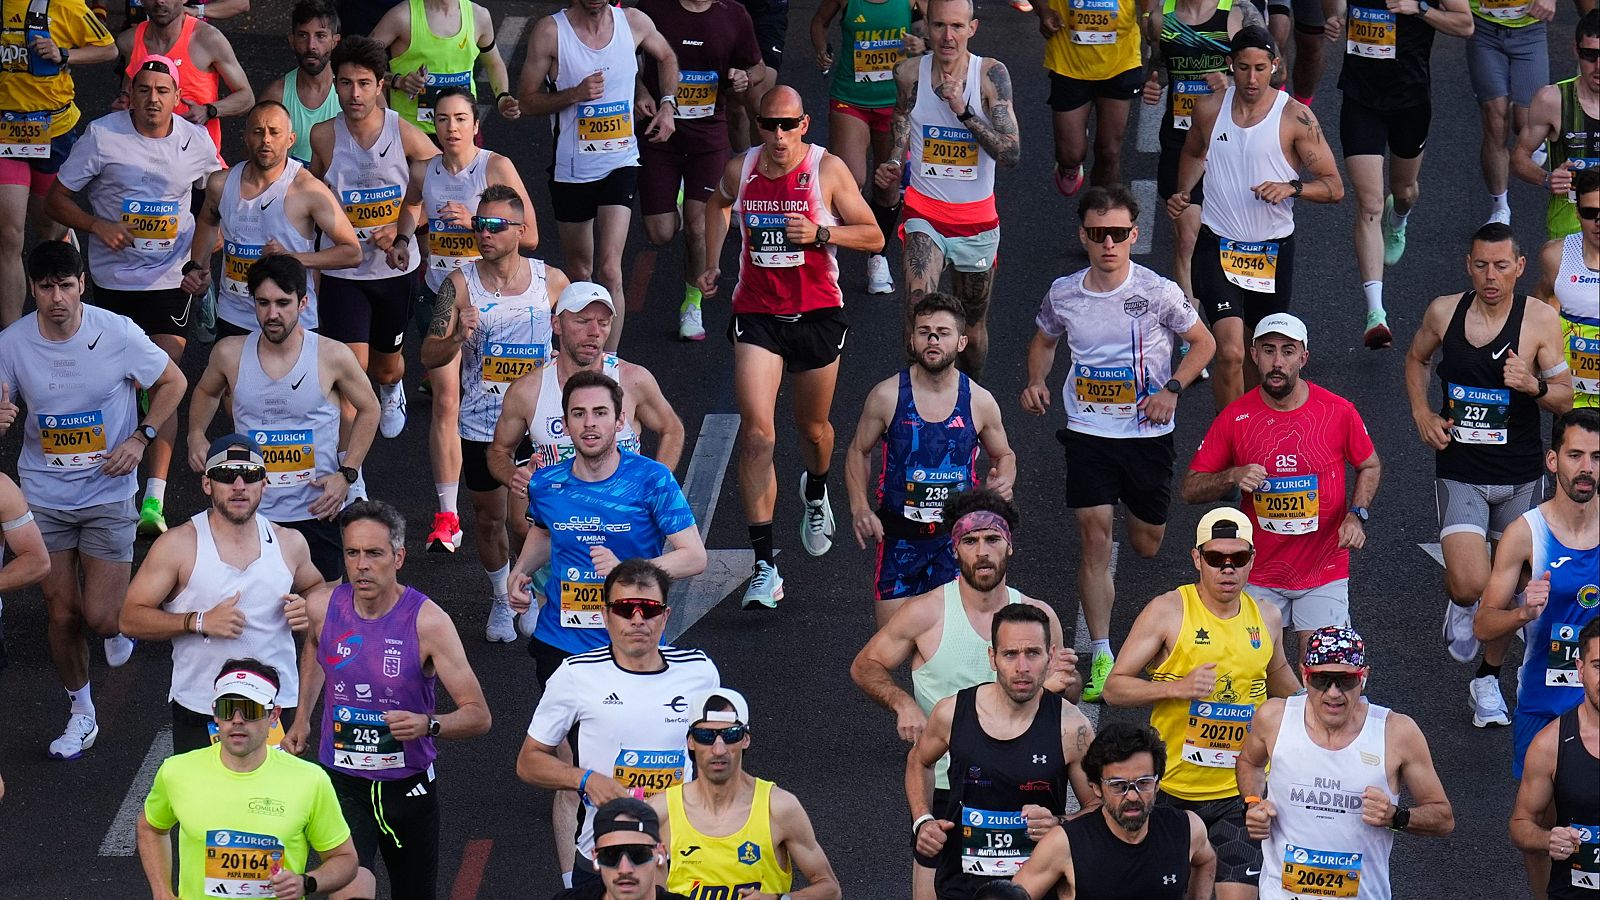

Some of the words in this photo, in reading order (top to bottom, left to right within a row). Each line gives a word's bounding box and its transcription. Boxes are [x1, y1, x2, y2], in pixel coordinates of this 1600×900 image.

[1077, 13, 1109, 25] 20336
[1355, 24, 1385, 38] 20178
[865, 52, 897, 65] 20510
[1169, 54, 1224, 69] TRIWILD
[677, 87, 708, 98] 20733
[598, 104, 625, 114] ZURICH
[9, 125, 41, 137] 20535
[590, 119, 620, 132] 20551
[943, 130, 973, 139] ZURICH
[933, 144, 967, 158] 20128
[365, 190, 395, 200] ZURICH
[357, 205, 392, 219] 20603
[743, 201, 779, 211] PUERTAS
[780, 201, 809, 212] LORCA
[132, 218, 167, 231] 20672
[439, 237, 473, 249] 20590
[761, 231, 784, 244] 218
[238, 248, 262, 256] ZURIC
[232, 262, 250, 275] 205
[1231, 256, 1265, 270] 20546
[495, 361, 533, 375] 20473
[1087, 383, 1122, 396] 20257
[1468, 392, 1502, 401] ZURICH
[61, 415, 95, 425] ZURICH
[1464, 406, 1489, 421] 237
[53, 431, 91, 446] 20671
[271, 433, 305, 442] ZURICH
[263, 450, 301, 463] 20440
[1275, 454, 1297, 467] as
[930, 471, 961, 480] ZURICH
[1275, 480, 1310, 489] ZURICH
[925, 487, 949, 500] 238
[1266, 496, 1304, 510] 20521
[574, 588, 605, 602] 2021
[336, 643, 351, 657] kp
[354, 713, 384, 721] ZURIC
[1216, 708, 1252, 717] ZURICH
[353, 728, 380, 744] 243
[1200, 723, 1244, 741] 20210
[1209, 741, 1231, 749] RAMIRO
[643, 755, 679, 763] ZURICH
[628, 773, 673, 789] 20452
[1314, 777, 1340, 791] RUN
[1290, 787, 1363, 810] MADRID
[248, 801, 285, 813] COMILLAS
[988, 816, 1028, 825] ZURICH
[235, 835, 276, 846] ZURICH
[985, 833, 1013, 848] 159
[221, 853, 268, 870] 20164
[1312, 854, 1353, 865] ZURICH
[1297, 870, 1344, 888] 20624
[1302, 887, 1323, 895] MIGUEL
